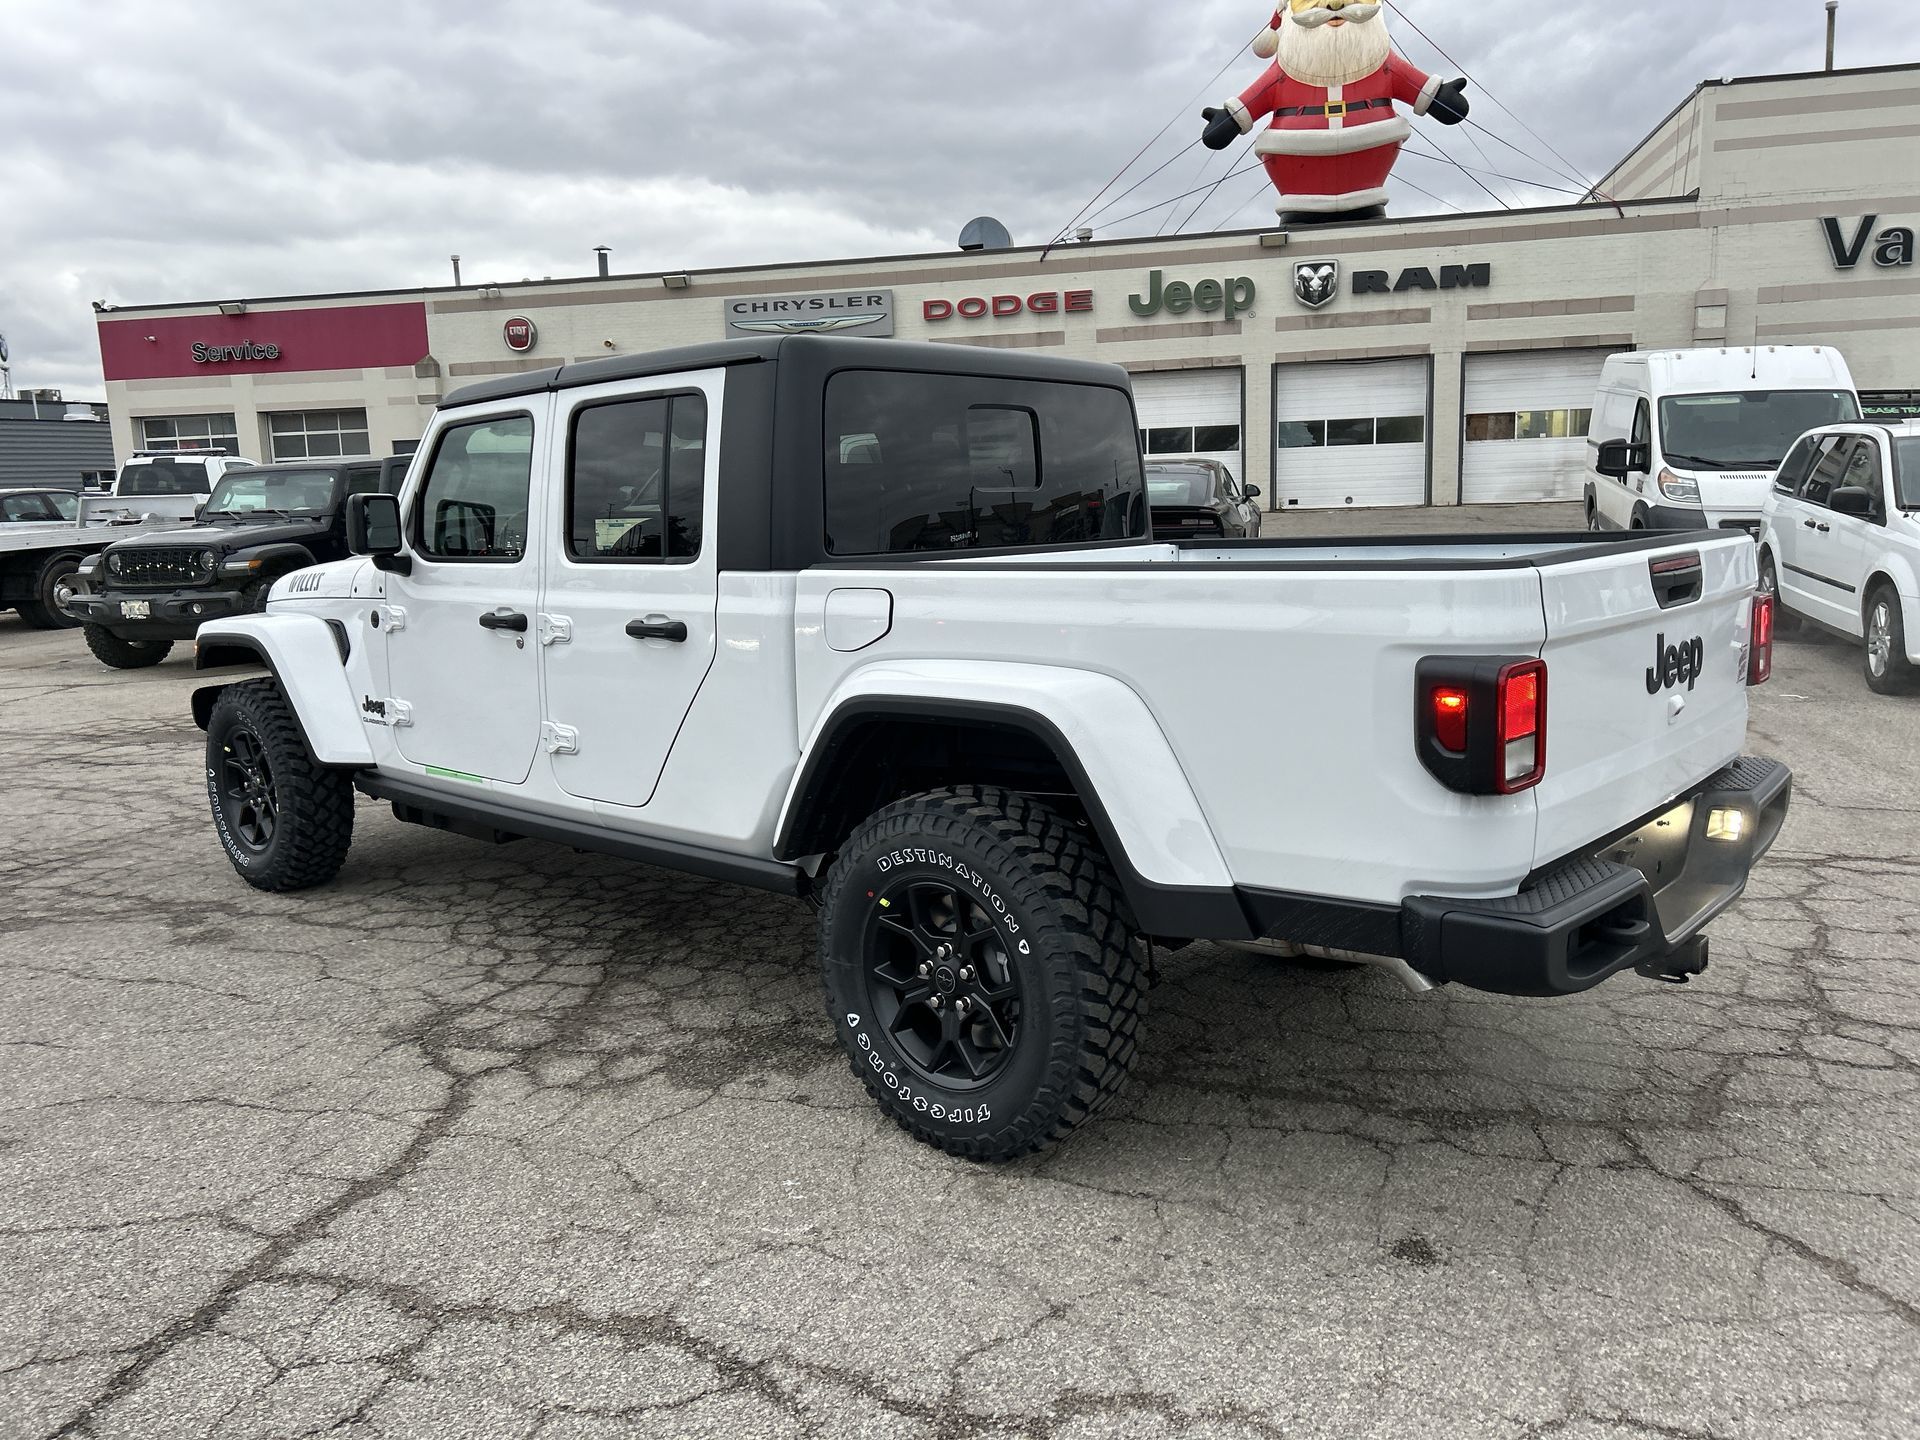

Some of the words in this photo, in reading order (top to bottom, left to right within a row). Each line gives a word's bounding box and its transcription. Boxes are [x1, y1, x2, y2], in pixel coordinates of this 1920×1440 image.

[1820, 212, 1915, 269] Va
[1352, 262, 1491, 294] RAM
[732, 295, 884, 314] CHRYSLER
[923, 289, 1094, 321] DODGE
[1127, 269, 1257, 320] Jeep
[190, 339, 279, 363] Service
[288, 572, 326, 592] WILLYS
[1645, 631, 1704, 695] Jeep
[362, 694, 386, 719] Jeep
[876, 848, 1020, 934] DESTINATION
